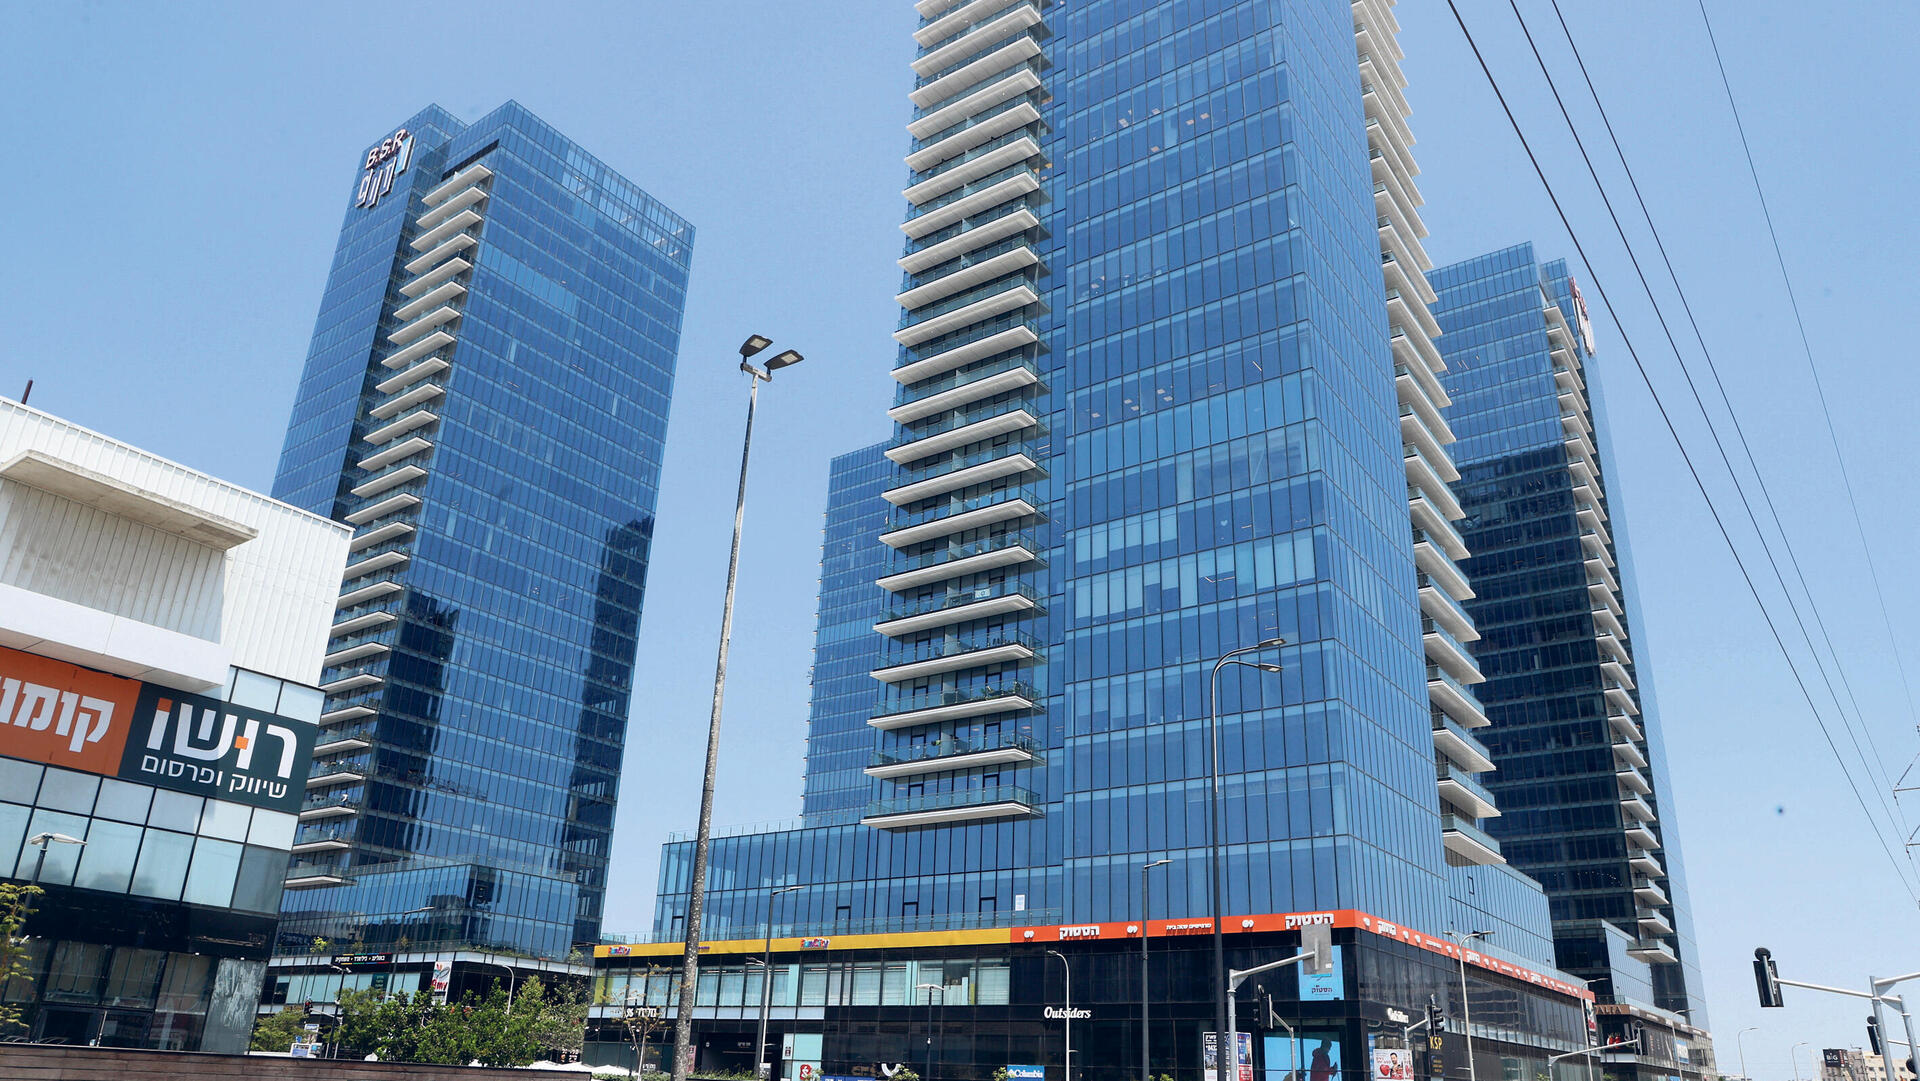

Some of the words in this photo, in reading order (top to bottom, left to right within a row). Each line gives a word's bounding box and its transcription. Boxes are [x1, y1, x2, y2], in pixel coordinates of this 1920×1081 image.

[0, 676, 115, 753] קומו
[141, 754, 223, 787] ופרסום
[229, 773, 287, 799] שיווק
[1284, 913, 1334, 930] הסטוק
[1059, 926, 1100, 940] הסטוק
[1430, 1036, 1443, 1050] KSP
